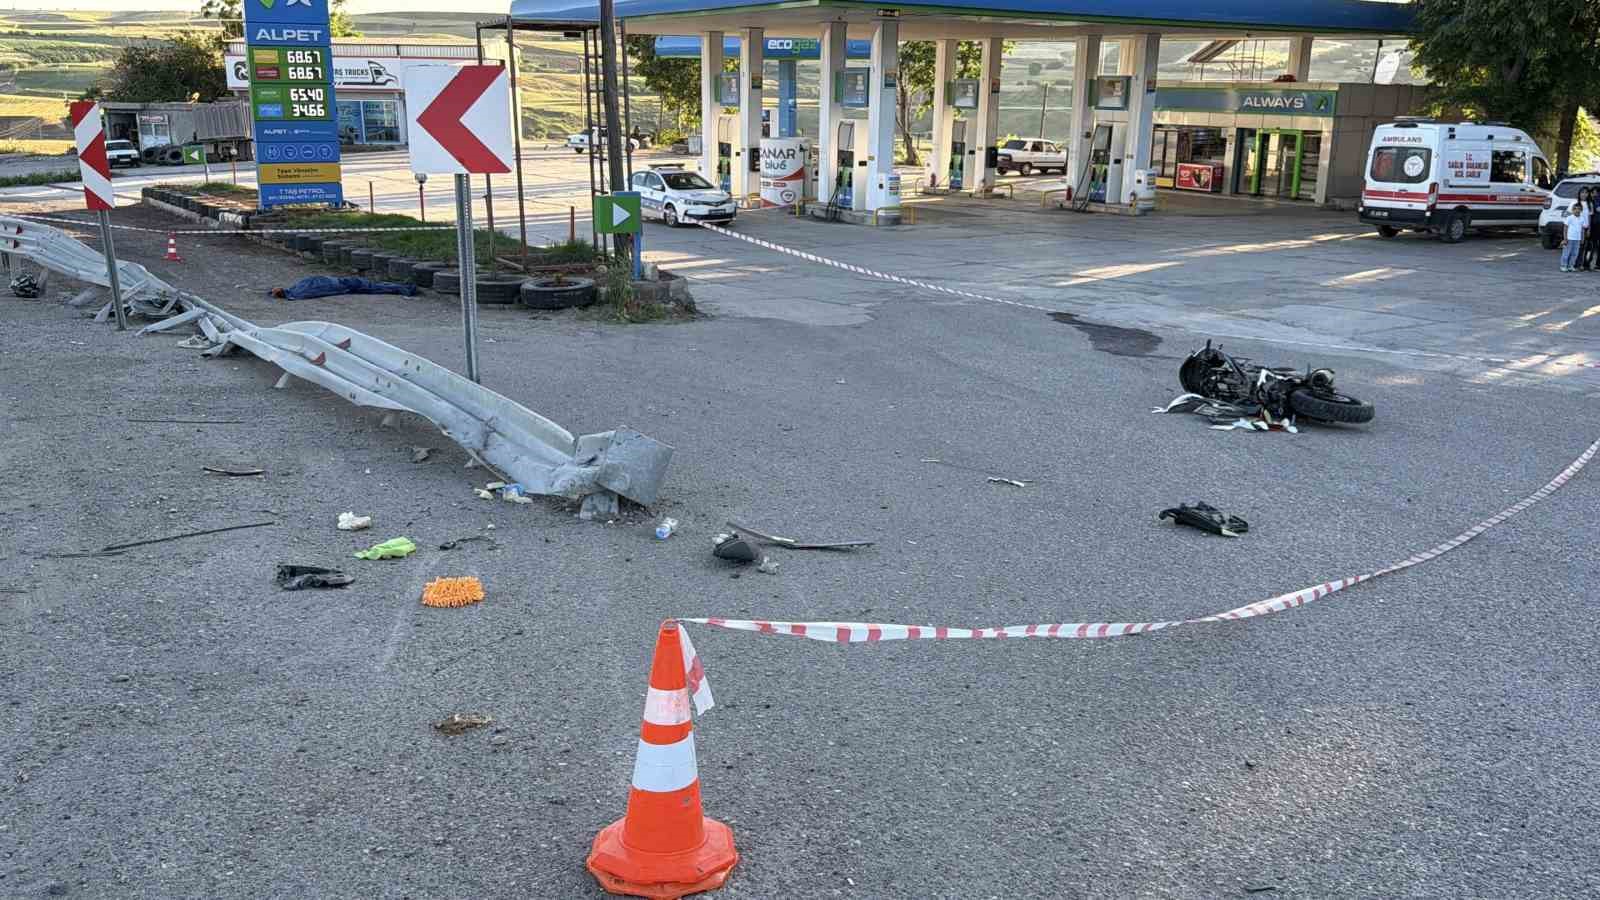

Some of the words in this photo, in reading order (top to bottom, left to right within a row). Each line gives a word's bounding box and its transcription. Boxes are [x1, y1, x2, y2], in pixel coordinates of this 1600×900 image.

[256, 29, 321, 41] ALPET
[287, 51, 321, 63] 68.67
[288, 67, 323, 79] 68.67
[345, 68, 369, 76] TRUCKS
[290, 88, 324, 101] 65.40
[1242, 97, 1305, 109] ALWAYS
[292, 104, 325, 117] 34.66
